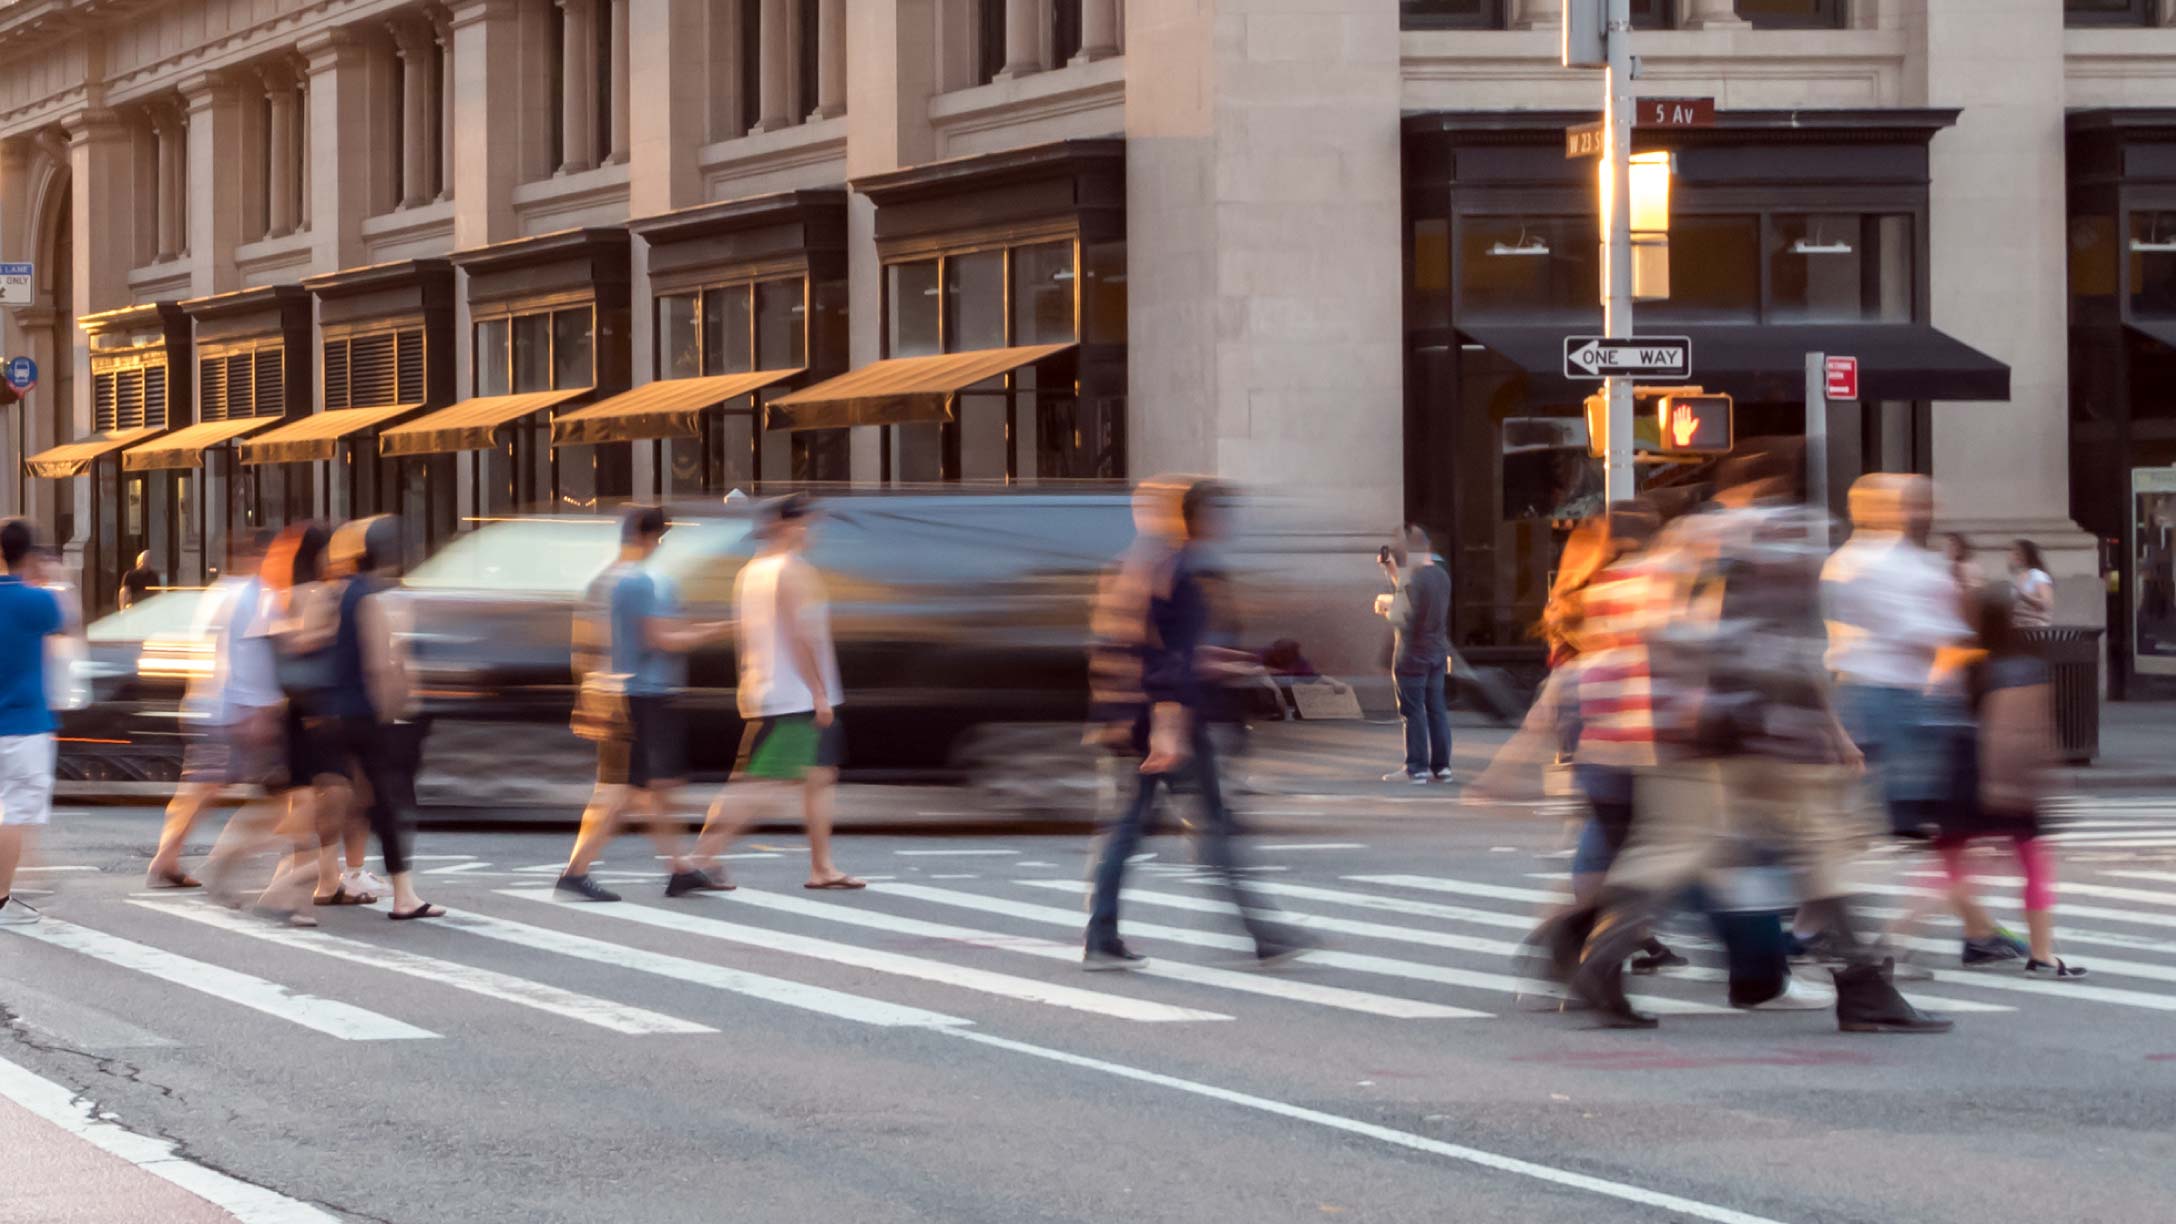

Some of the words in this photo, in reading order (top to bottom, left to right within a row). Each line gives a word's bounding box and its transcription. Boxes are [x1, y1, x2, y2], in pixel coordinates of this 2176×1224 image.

[1656, 104, 1664, 123] 5
[1673, 105, 1693, 124] Av
[1569, 135, 1579, 153] W
[1581, 133, 1591, 152] 23
[1595, 131, 1601, 150] S
[4, 266, 28, 274] LANE
[6, 276, 28, 285] ONLY
[1583, 349, 1618, 365] ONE
[1640, 349, 1678, 365] WAY
